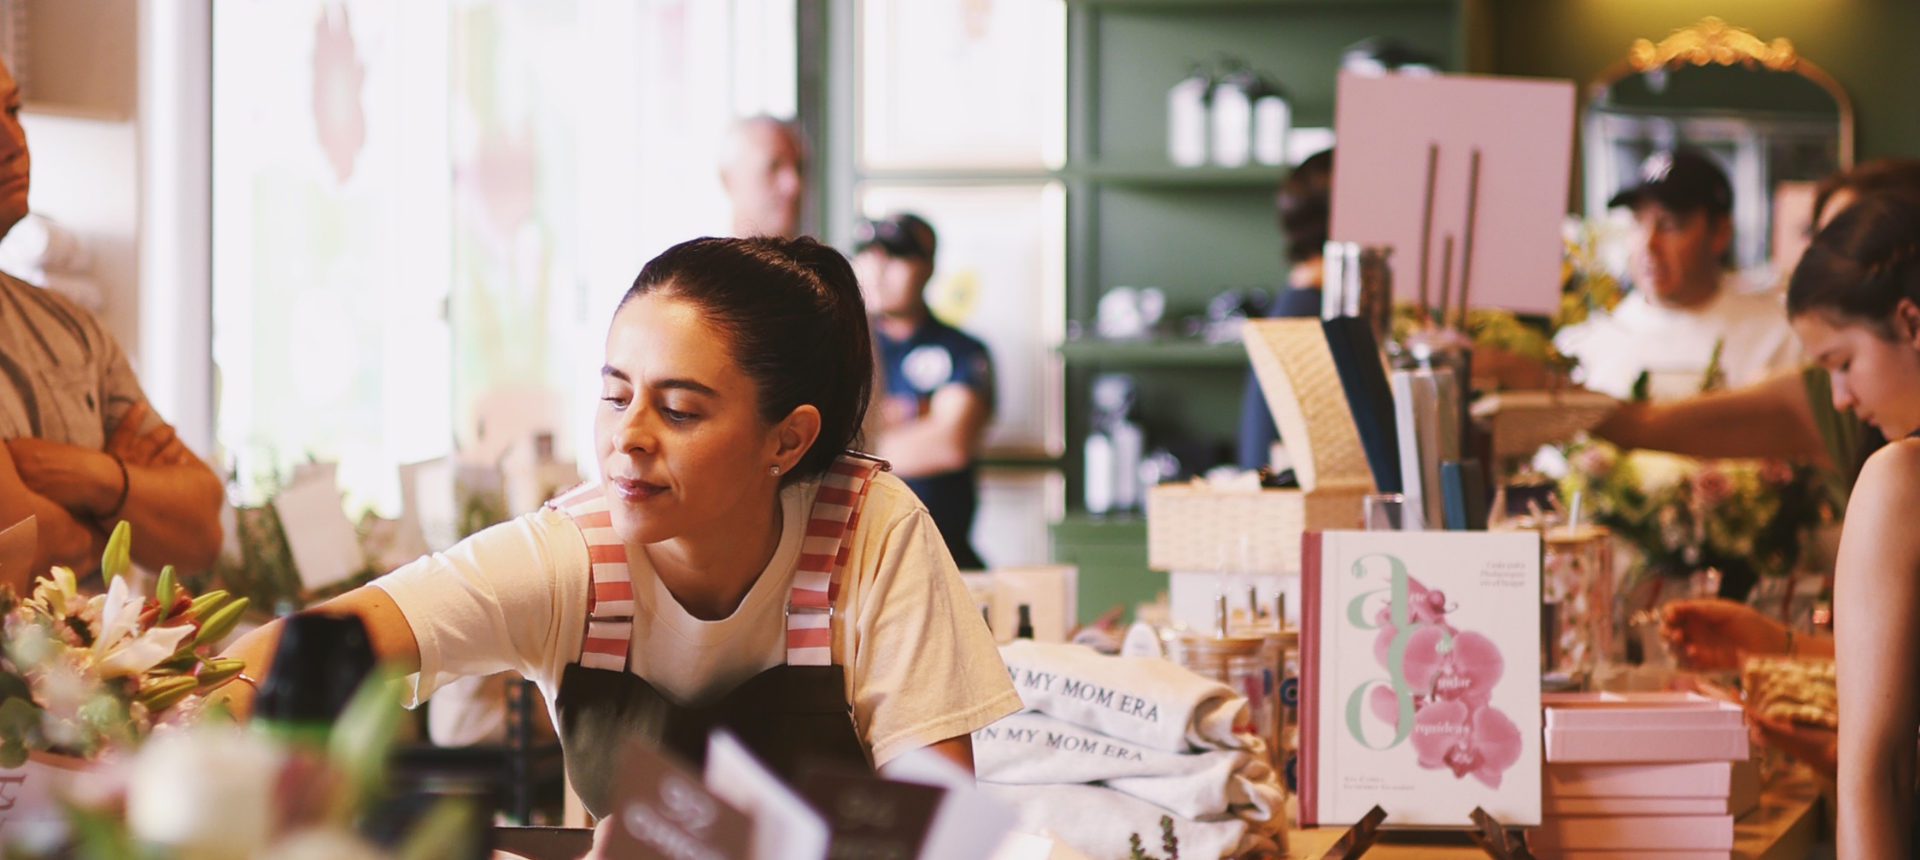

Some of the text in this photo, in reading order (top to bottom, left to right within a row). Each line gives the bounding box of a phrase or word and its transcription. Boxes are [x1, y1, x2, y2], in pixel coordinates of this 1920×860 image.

[1024, 669, 1058, 691] MY
[1062, 677, 1115, 708] MOM
[1118, 694, 1158, 722] ERA
[975, 727, 1142, 761] IN MY MOM ERA
